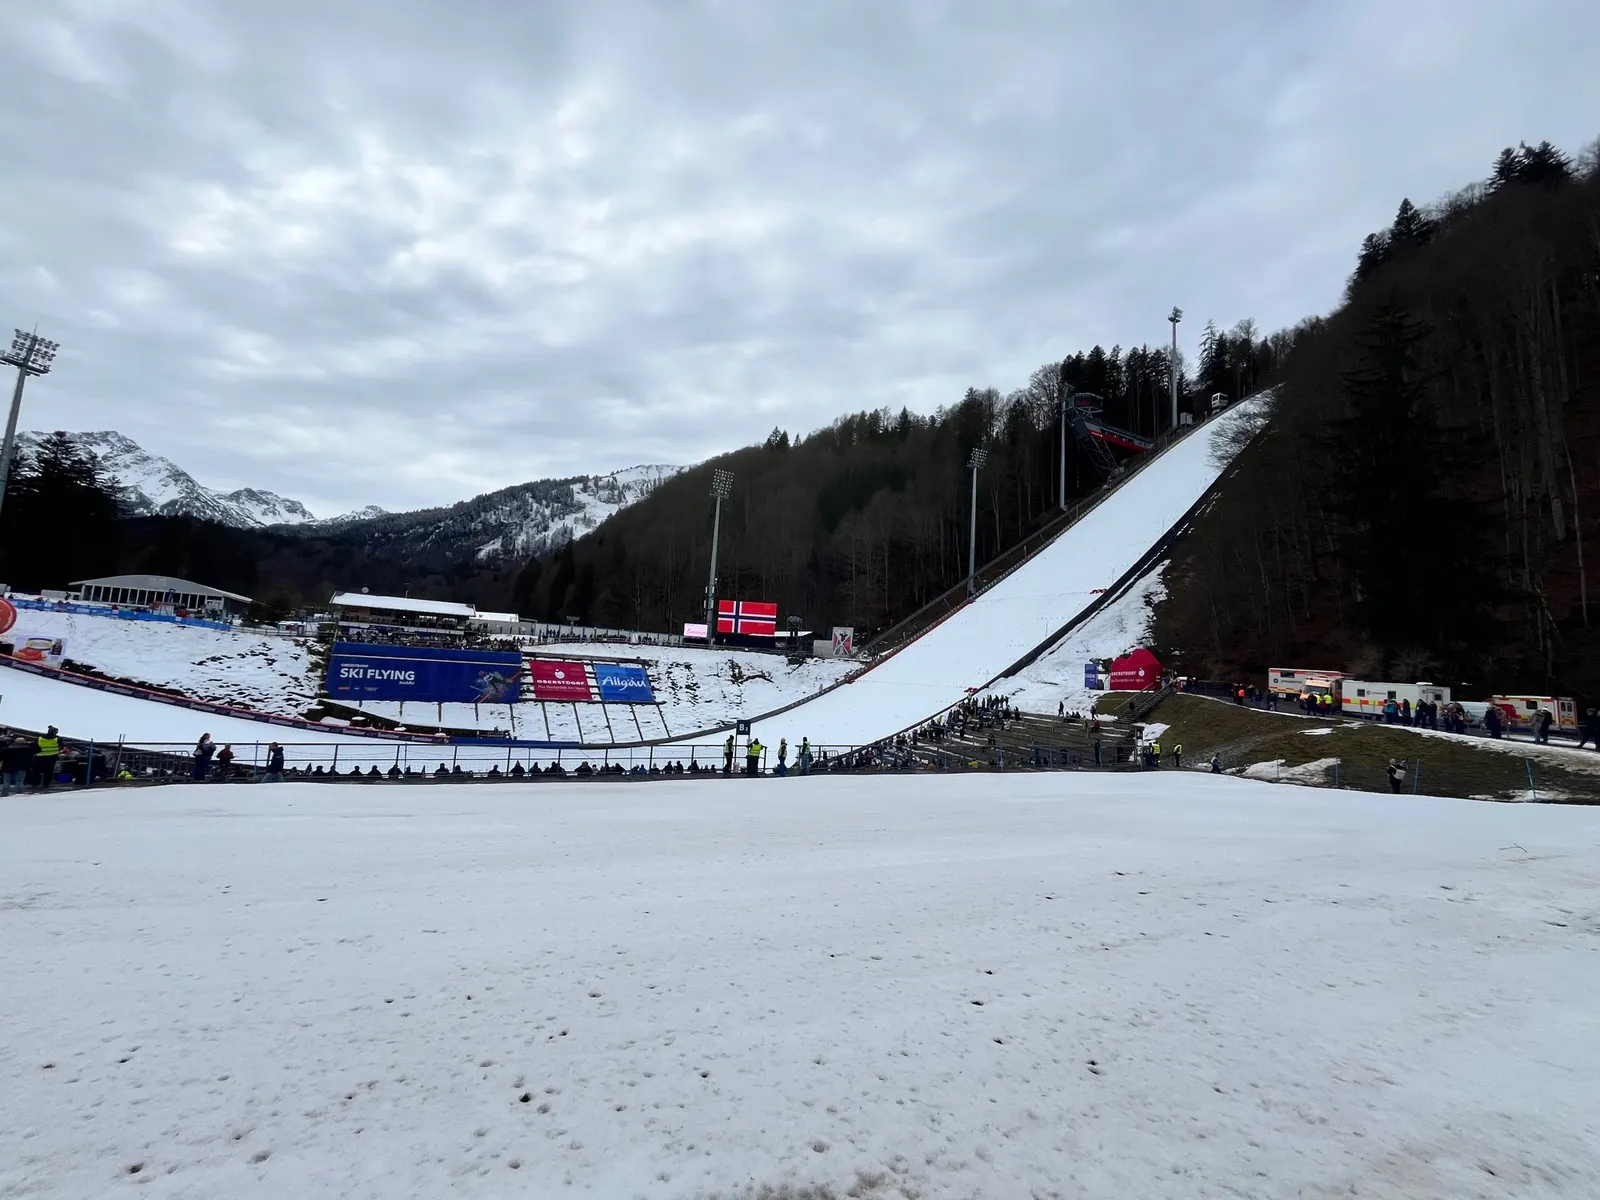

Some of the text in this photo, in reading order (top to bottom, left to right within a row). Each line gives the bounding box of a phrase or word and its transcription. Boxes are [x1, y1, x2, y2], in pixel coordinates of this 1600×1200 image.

[340, 668, 415, 680] SKI FLYING
[602, 676, 647, 690] Allgäu
